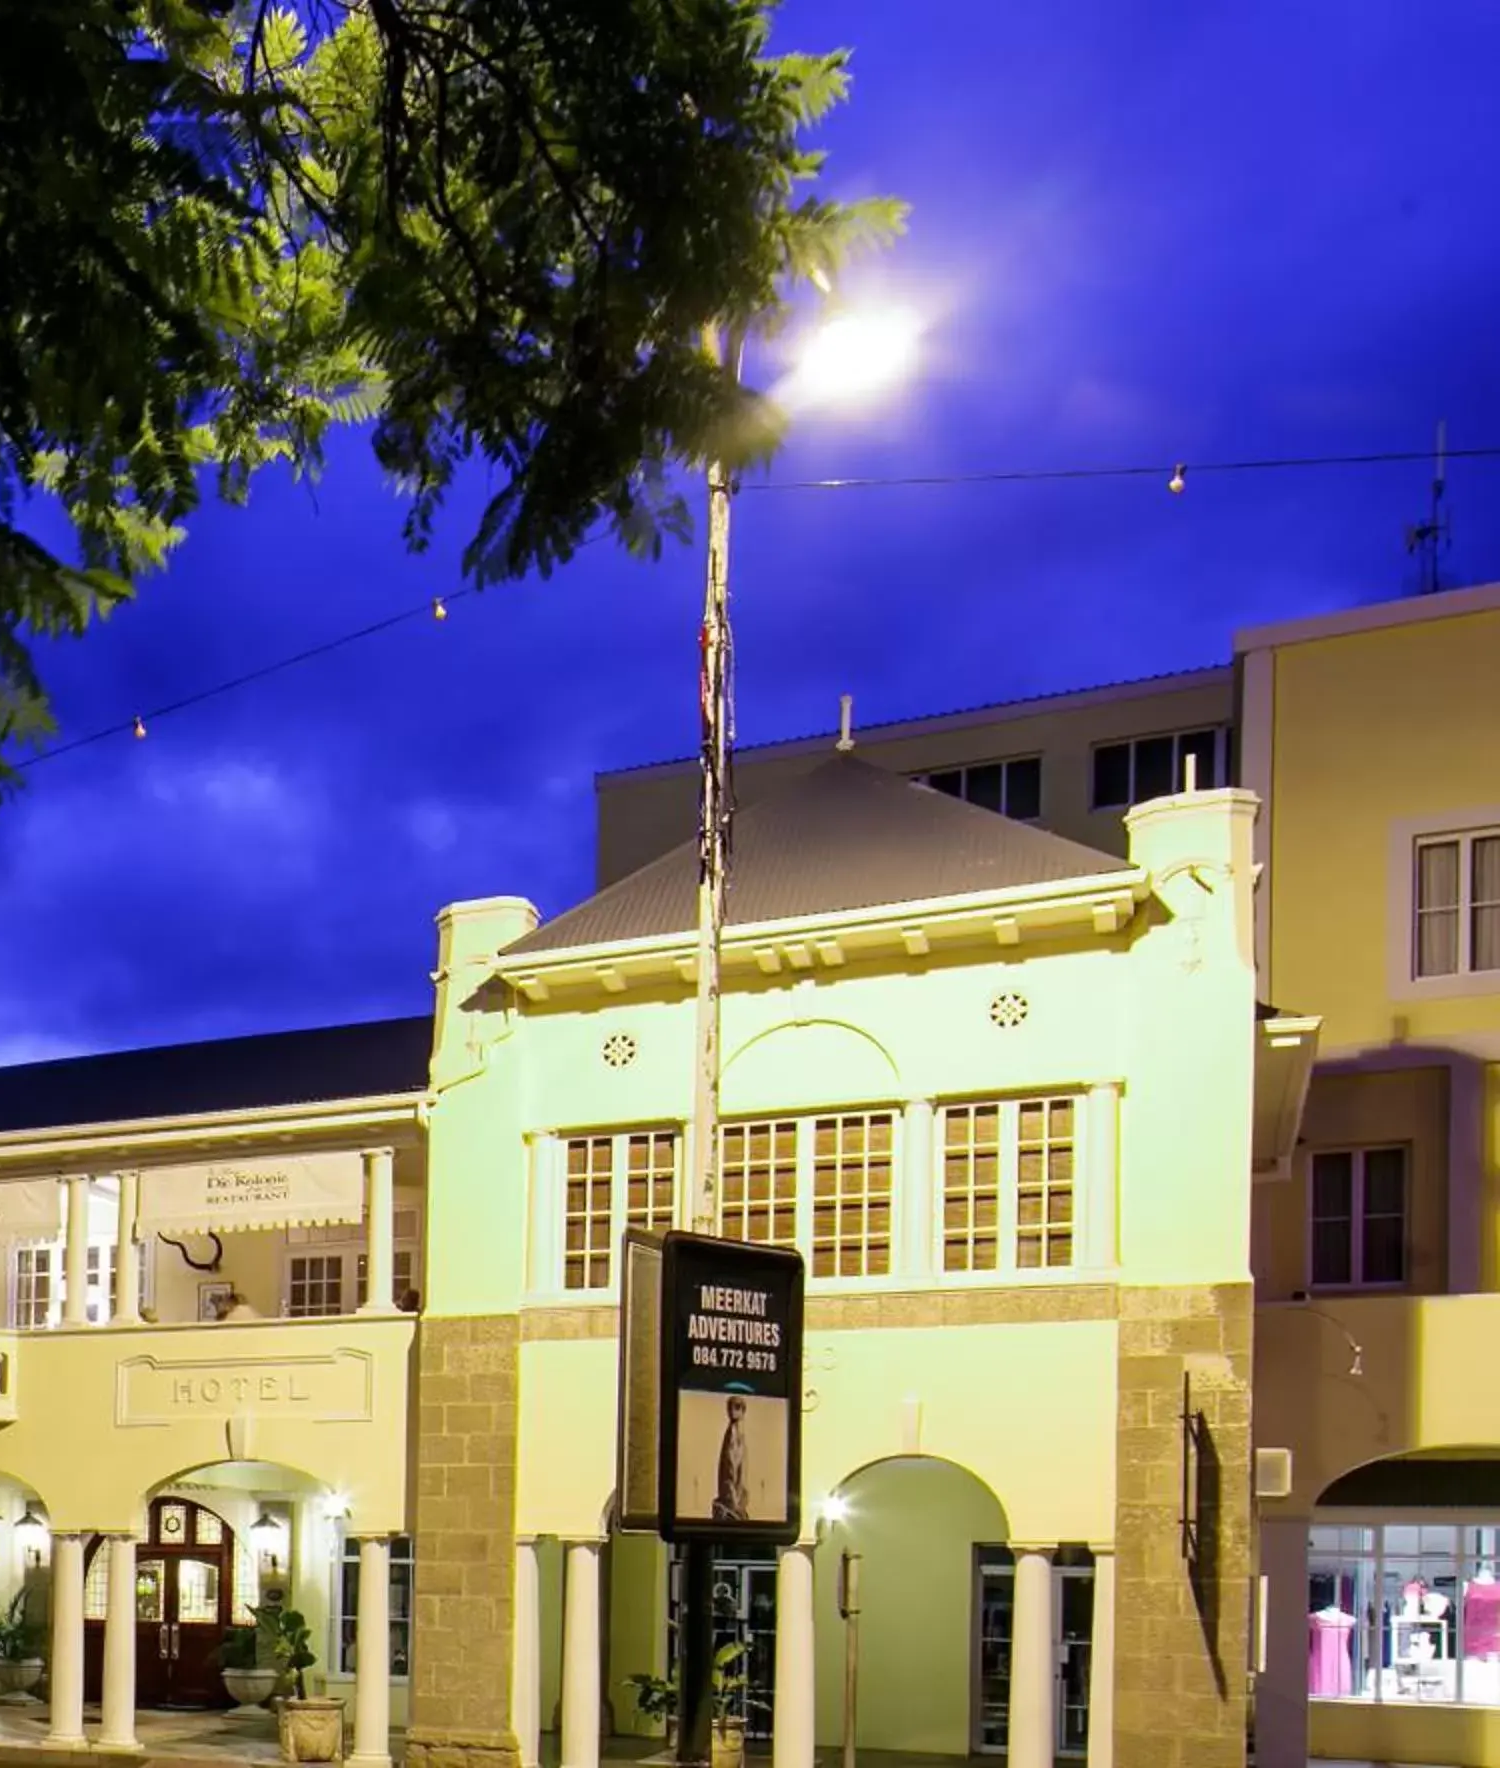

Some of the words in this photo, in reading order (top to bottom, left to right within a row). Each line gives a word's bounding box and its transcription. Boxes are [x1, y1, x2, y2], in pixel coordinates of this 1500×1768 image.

[206, 1176, 231, 1189] Die
[205, 1191, 289, 1205] RESTAURANT
[700, 1284, 768, 1317] MEERKAT
[688, 1313, 781, 1348] ADVENTURES
[720, 1347, 743, 1369] 772
[172, 1375, 311, 1404] HOTEL
